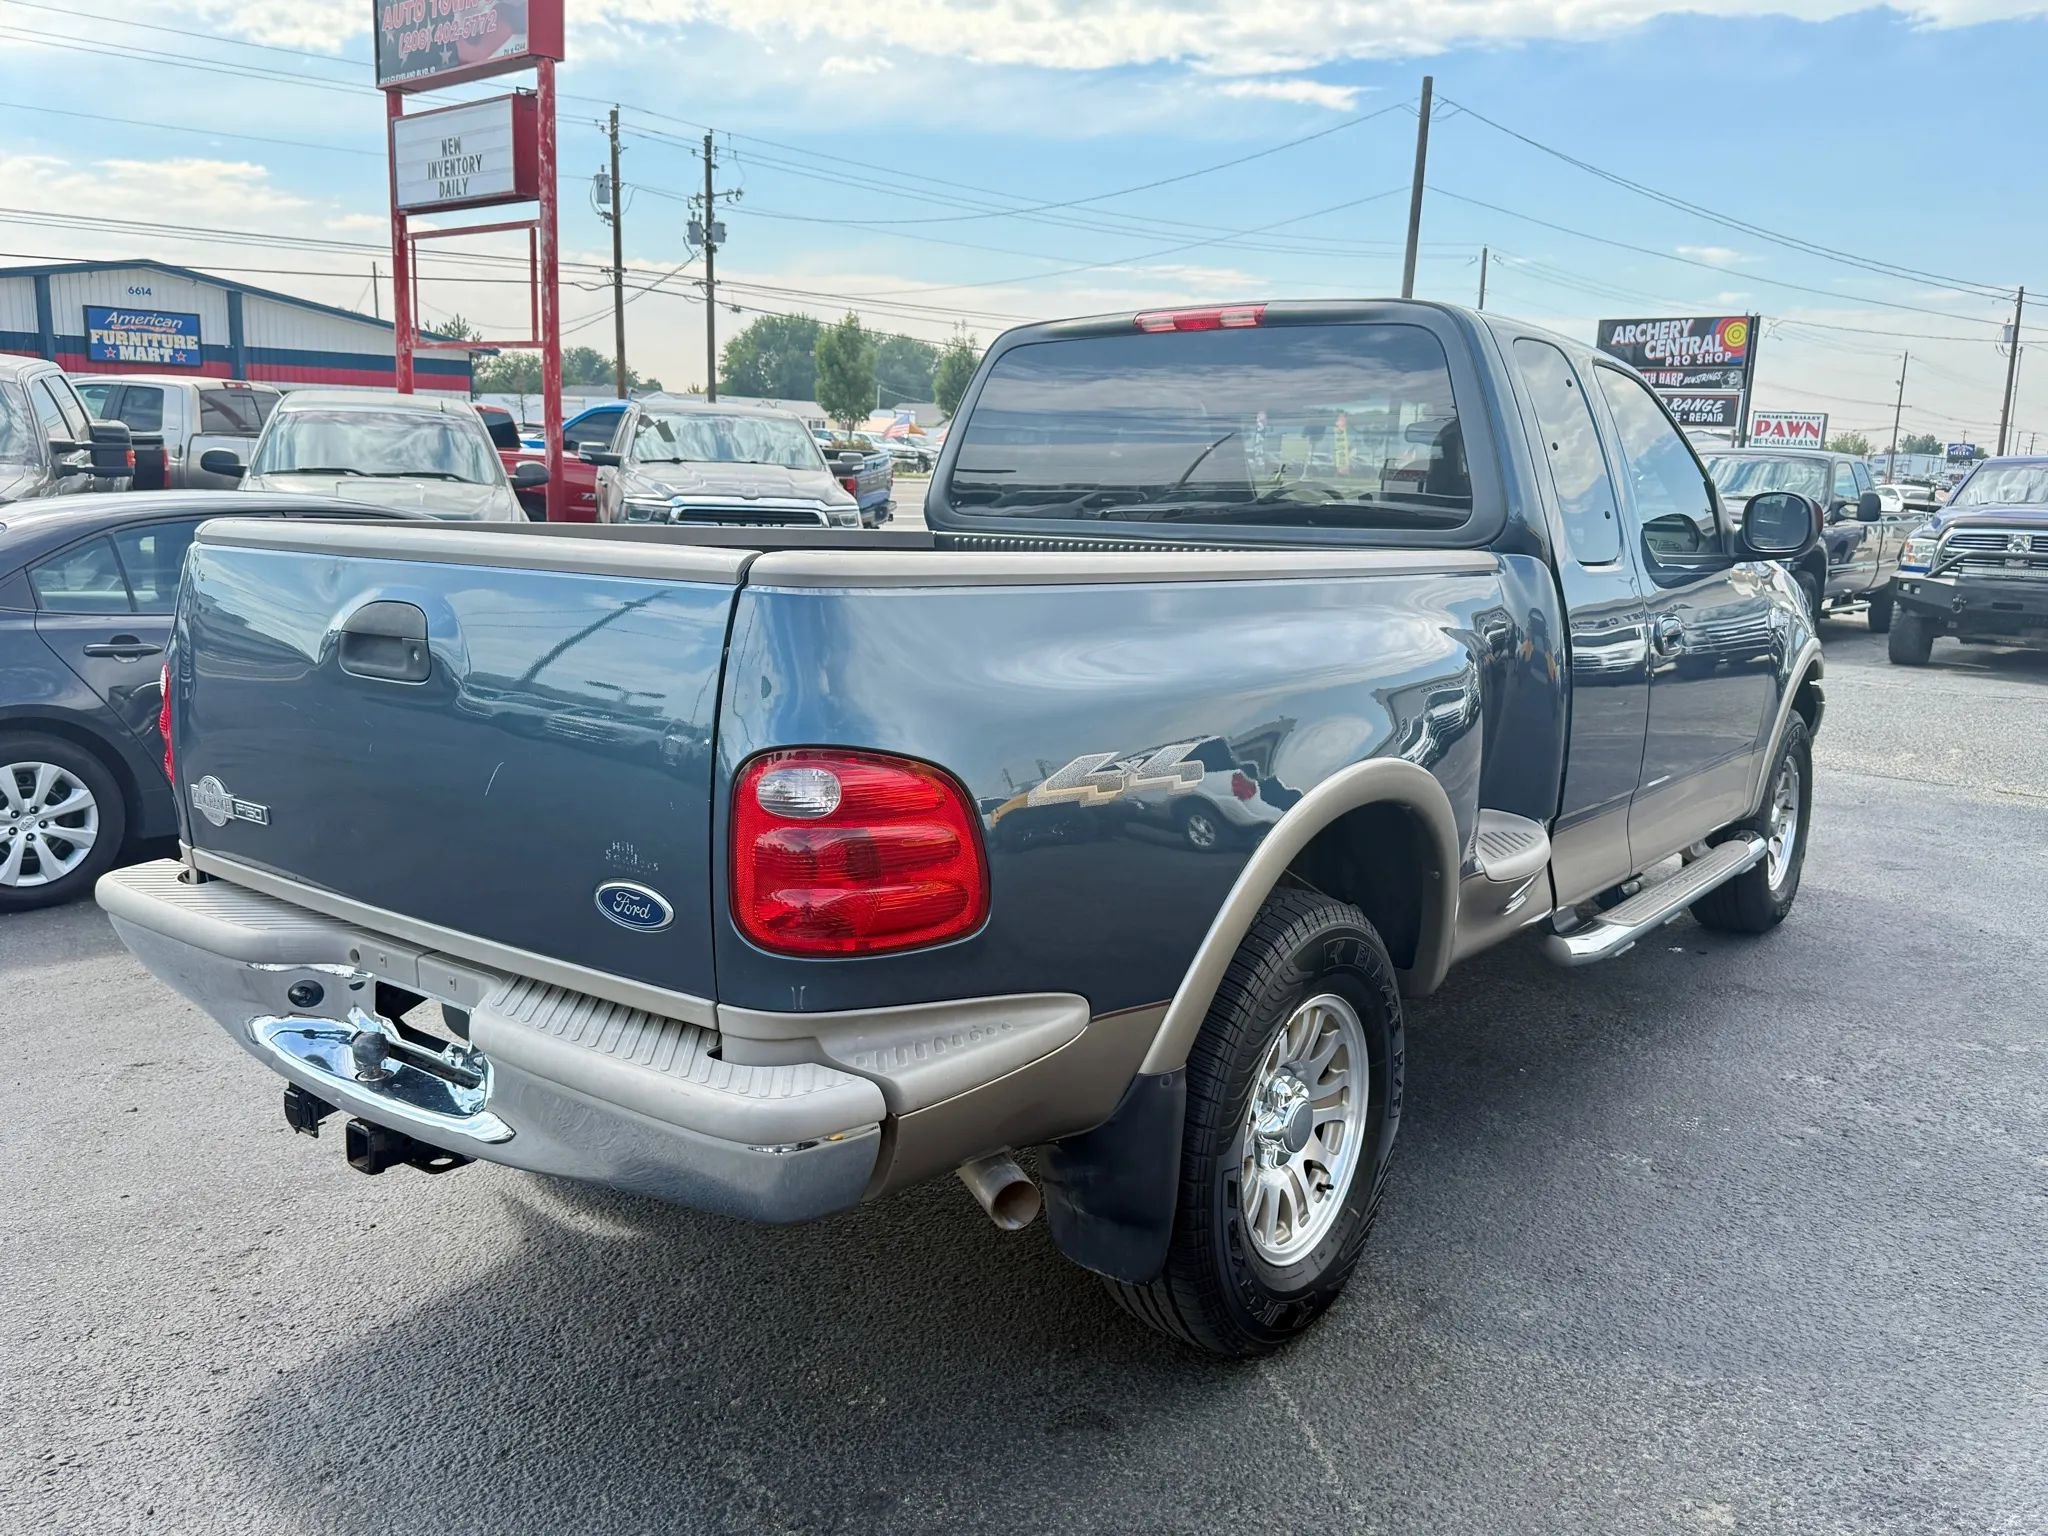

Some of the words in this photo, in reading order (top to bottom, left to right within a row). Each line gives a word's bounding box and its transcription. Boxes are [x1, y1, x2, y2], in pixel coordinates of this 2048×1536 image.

[382, 0, 427, 31] AUTO
[399, 27, 431, 56] (208)
[434, 9, 497, 45] 402-5772
[441, 137, 461, 157] NEW
[427, 154, 482, 180] INVENTORY
[439, 177, 469, 198] DAILY
[128, 286, 152, 296] 6614
[104, 312, 183, 328] American
[90, 329, 199, 350] FURNITURE
[1611, 319, 1695, 345] ARCHERY
[118, 346, 174, 362] MART
[1644, 334, 1724, 359] CENTRAL
[1665, 353, 1691, 367] PRO
[1696, 351, 1732, 364] SHOP
[1659, 372, 1684, 387] HARP
[1670, 397, 1726, 412] RANGE
[1689, 412, 1724, 422] REPAIR
[1754, 419, 1821, 439] PAWN
[612, 891, 651, 919] Ford
